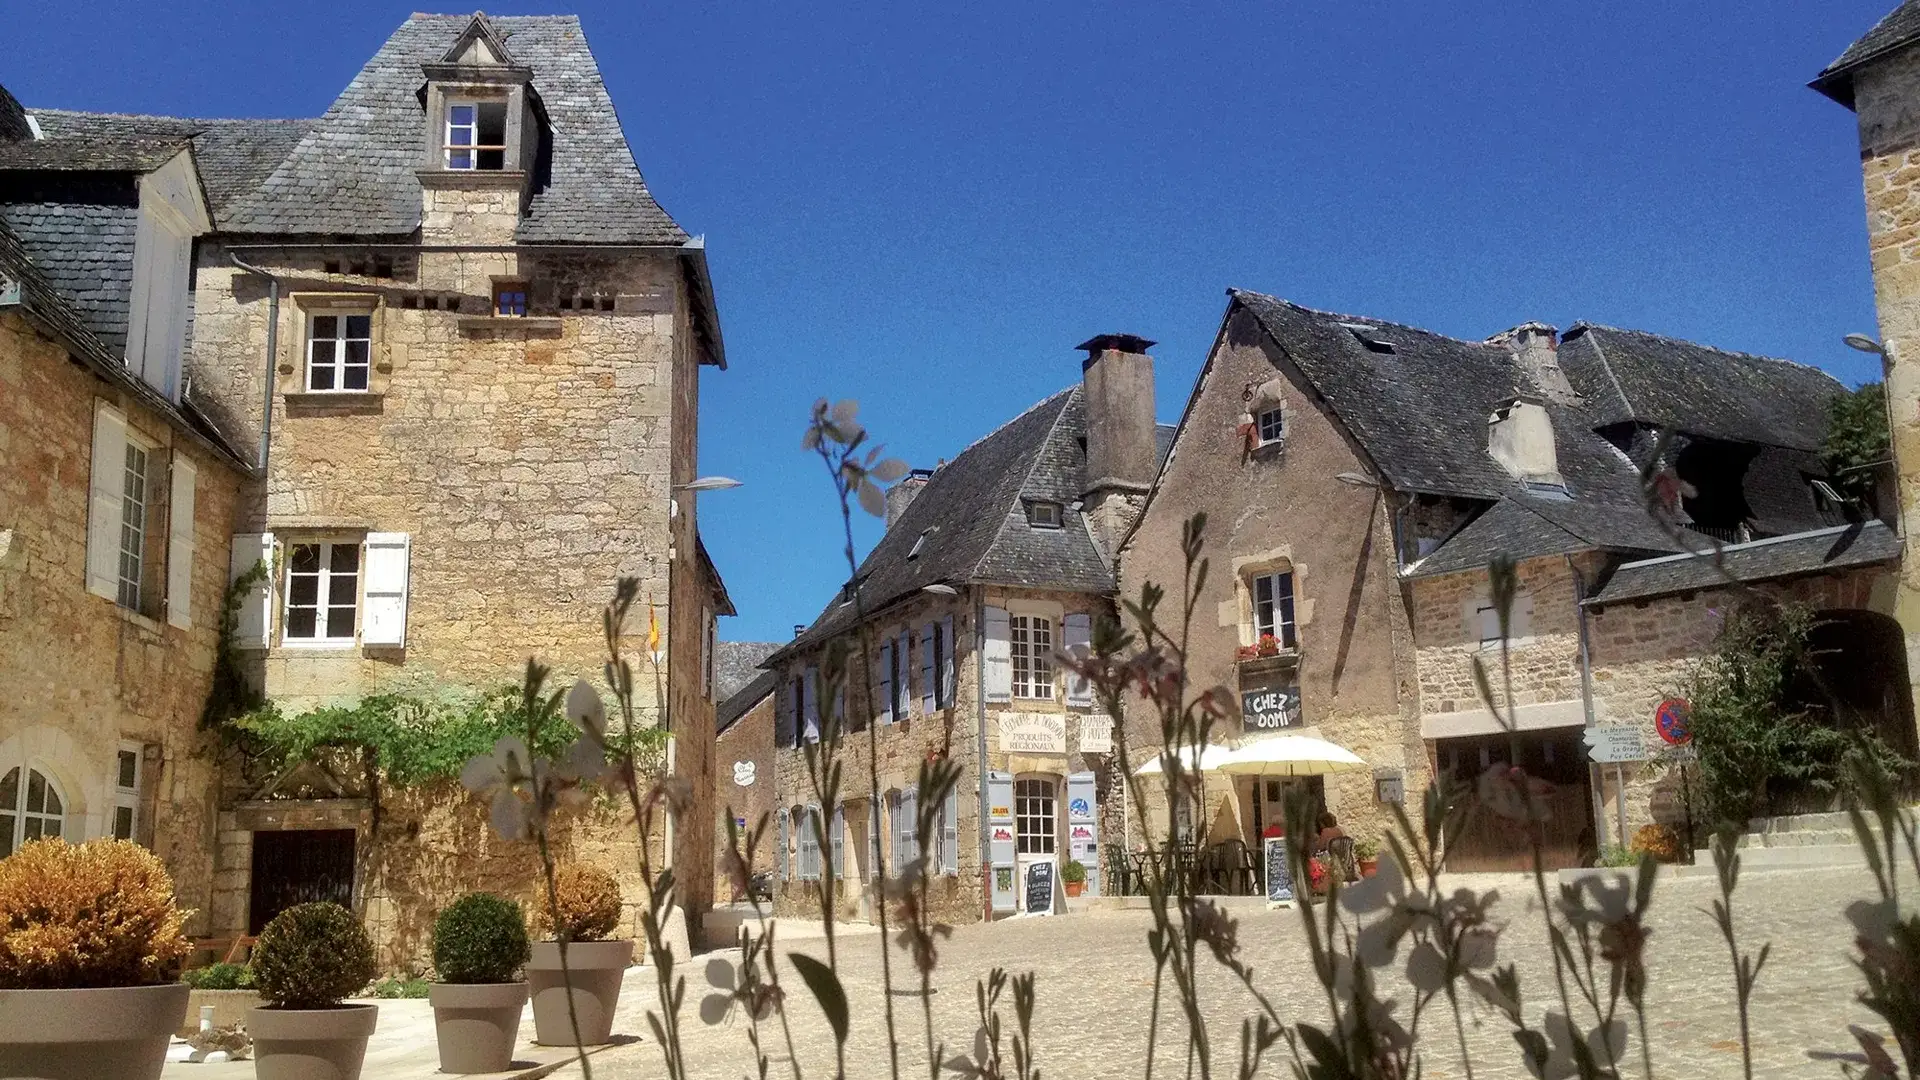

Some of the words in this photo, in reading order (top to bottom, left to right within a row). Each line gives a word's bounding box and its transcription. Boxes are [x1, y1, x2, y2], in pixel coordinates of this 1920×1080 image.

[1253, 693, 1287, 713] CHEZ
[1257, 711, 1289, 728] DOMI
[1013, 732, 1052, 742] PRODUITS
